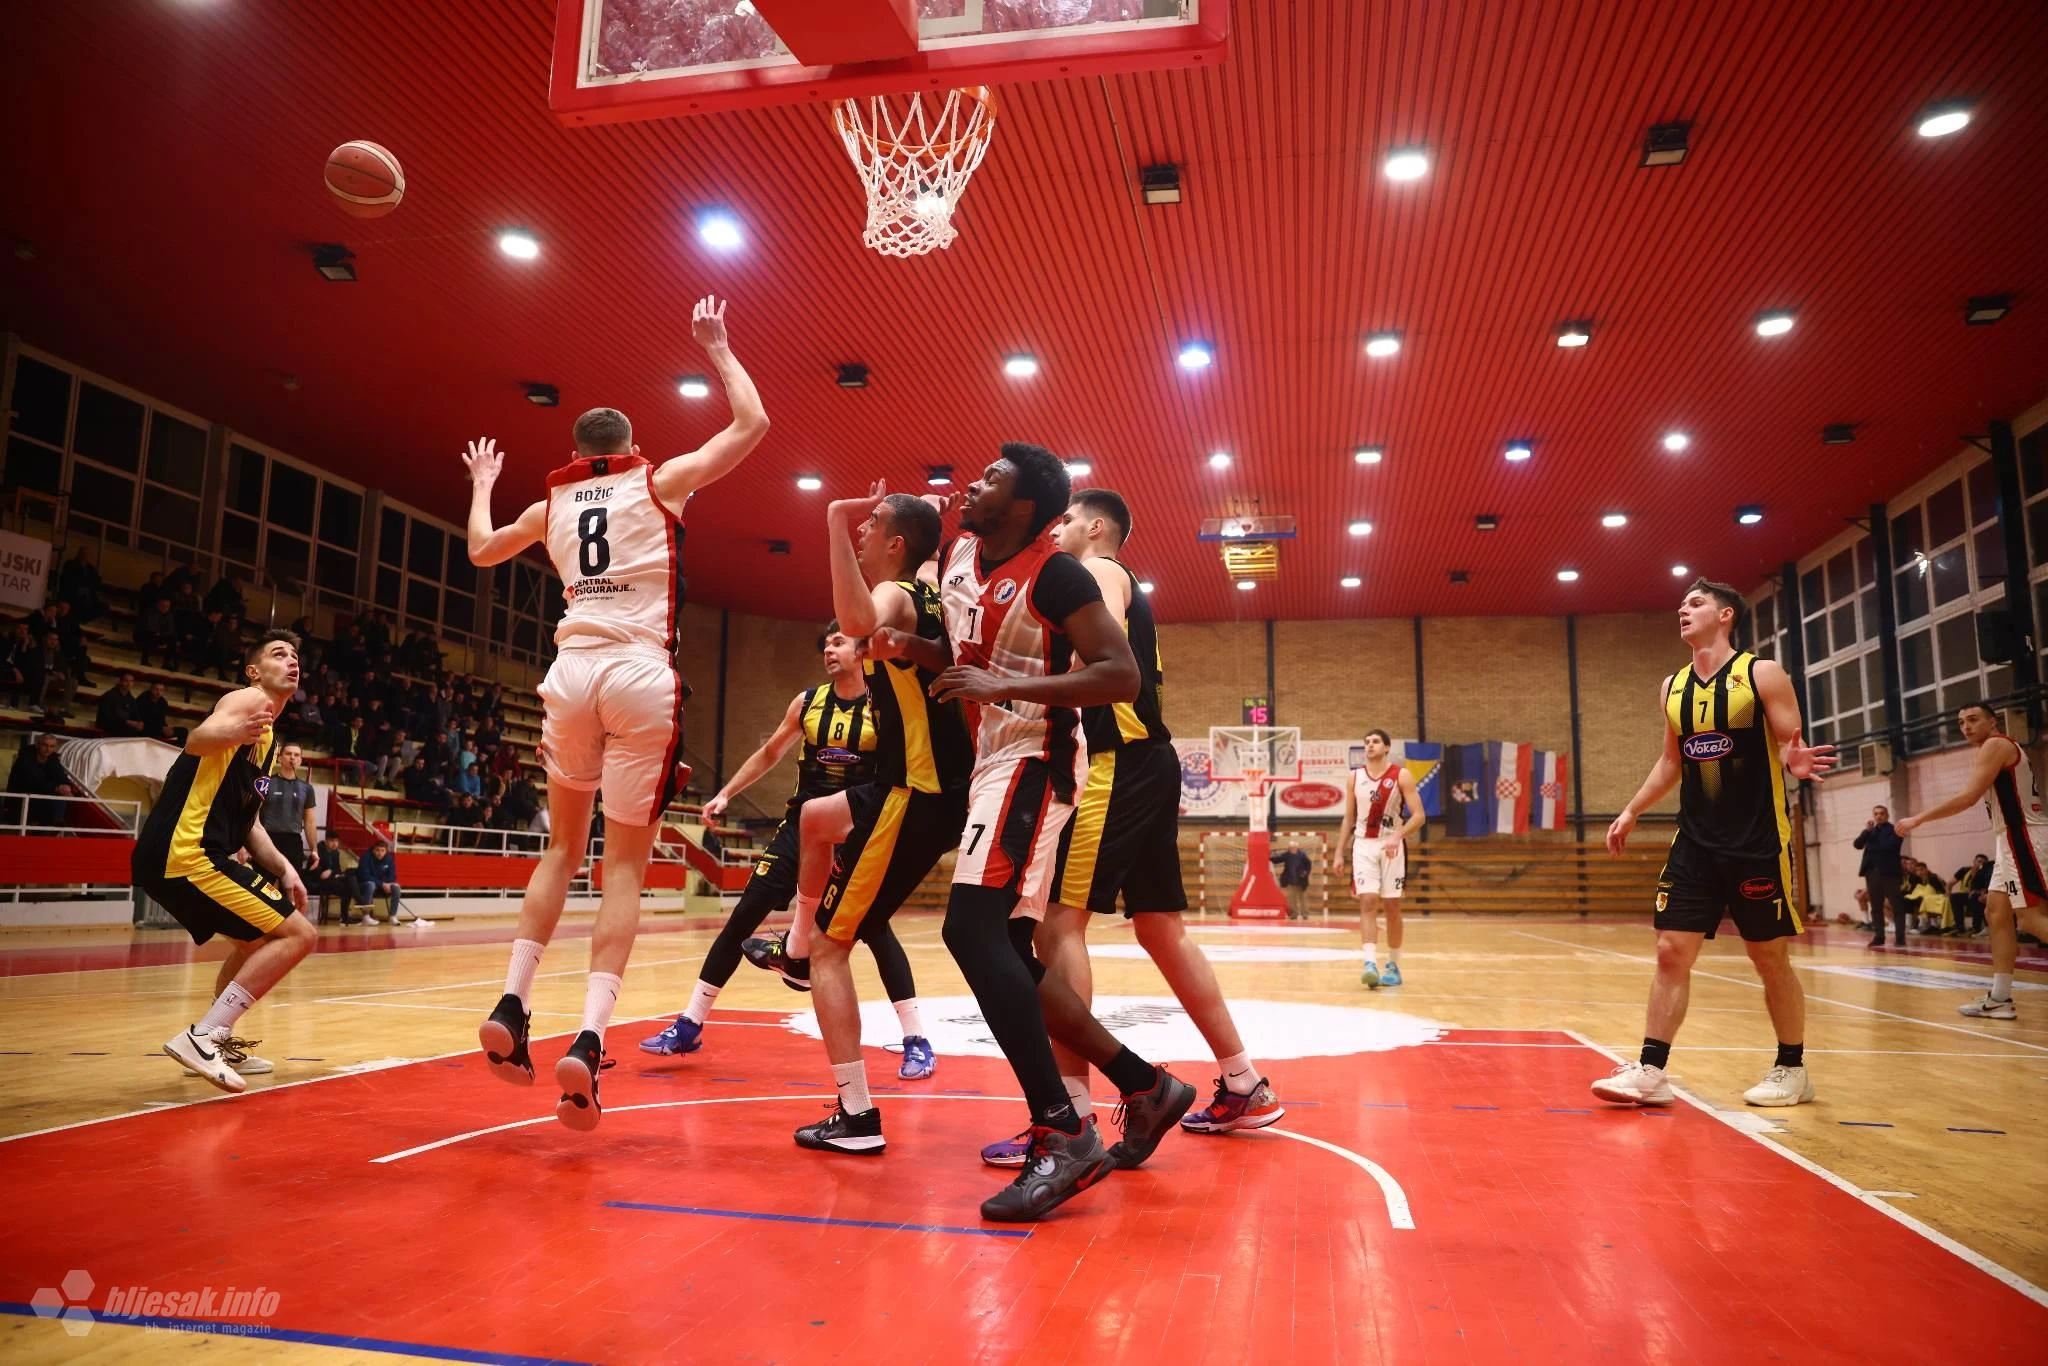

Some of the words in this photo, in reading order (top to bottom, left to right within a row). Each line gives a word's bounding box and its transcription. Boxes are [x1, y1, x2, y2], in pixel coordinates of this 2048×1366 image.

[578, 507, 610, 577] 8
[574, 578, 613, 589] CENTRAL
[574, 584, 630, 597] OSIGURANJE
[967, 607, 978, 641] 7
[1250, 707, 1268, 724] 15
[1698, 701, 1708, 724] 7
[833, 722, 845, 741] 8
[1370, 790, 1381, 802] 25
[966, 823, 986, 856] 7
[823, 884, 838, 910] 6
[1772, 898, 1783, 920] 7
